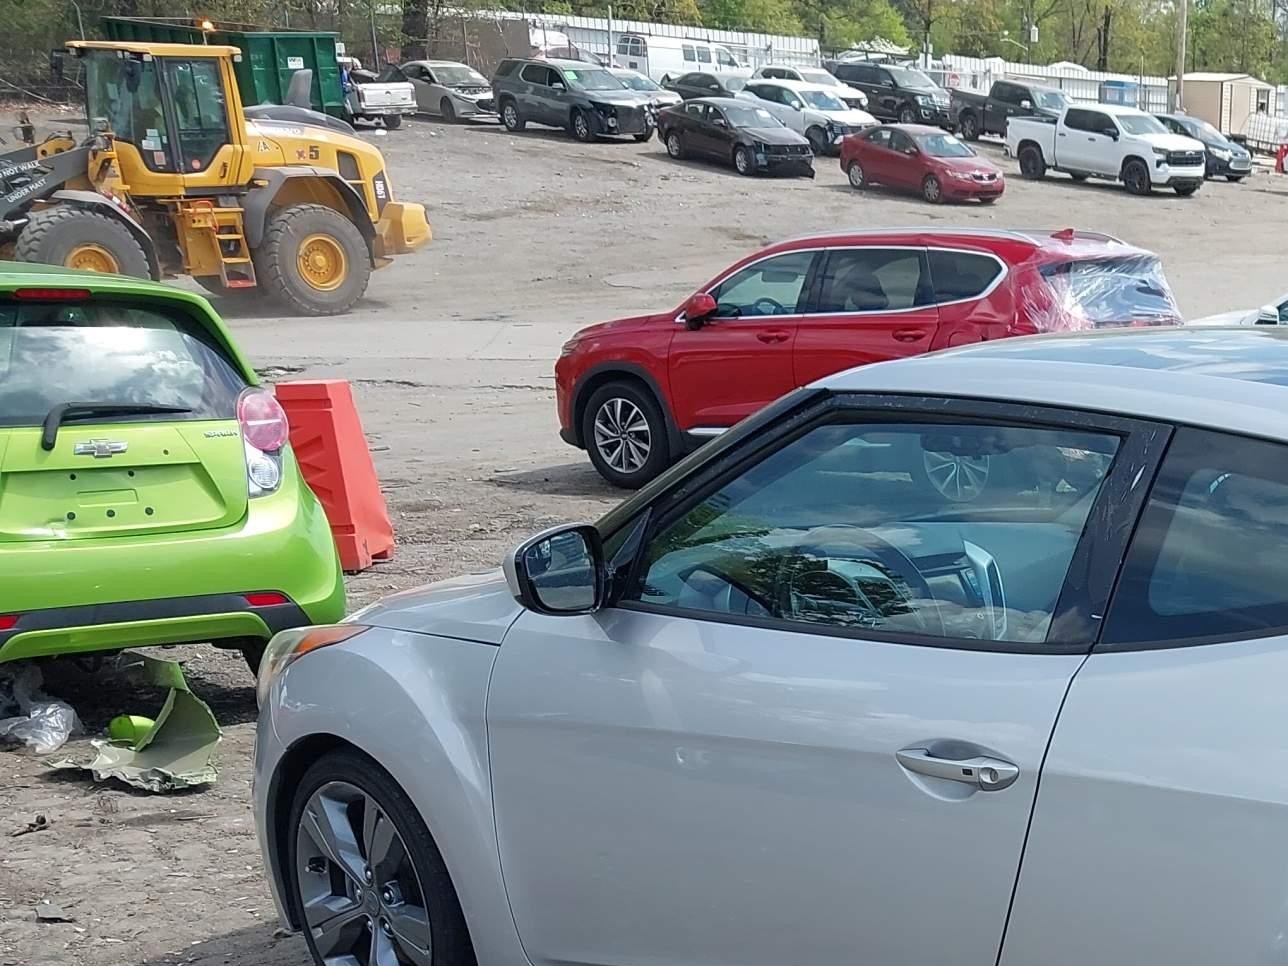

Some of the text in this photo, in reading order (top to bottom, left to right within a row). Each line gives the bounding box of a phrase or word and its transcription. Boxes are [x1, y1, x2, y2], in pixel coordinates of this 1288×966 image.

[309, 145, 320, 160] 5
[3, 166, 19, 177] NOT
[19, 160, 41, 171] WALK
[7, 178, 47, 203] UNDER MAST
